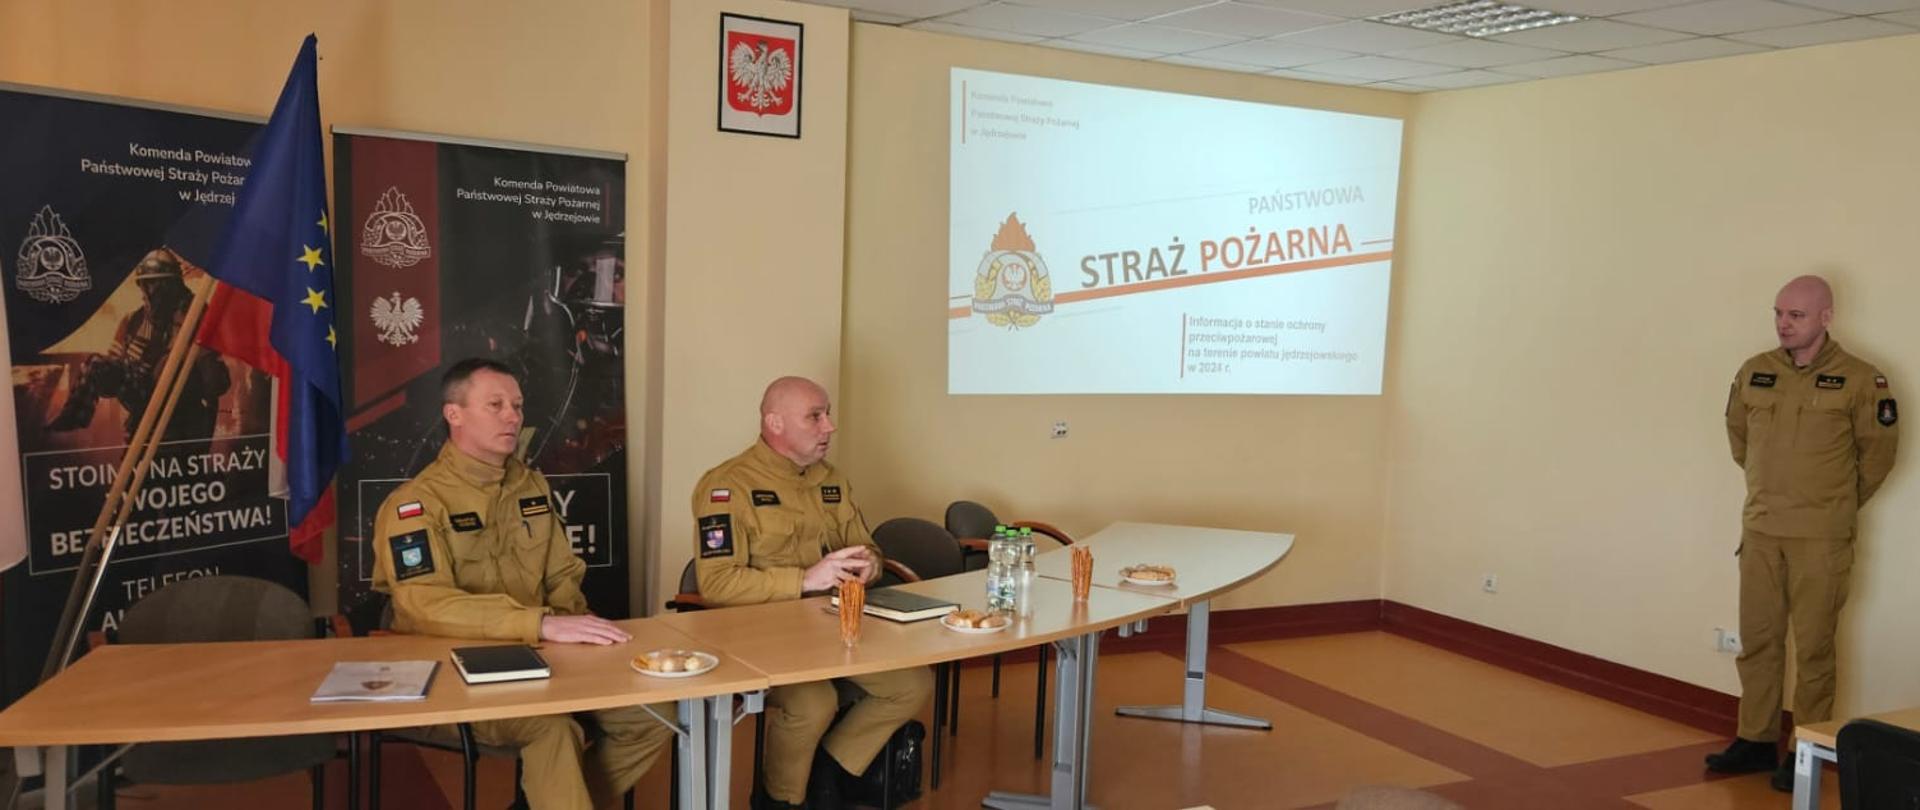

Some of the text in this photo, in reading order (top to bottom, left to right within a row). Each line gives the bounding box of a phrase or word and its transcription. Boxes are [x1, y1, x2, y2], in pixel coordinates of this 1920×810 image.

[129, 142, 252, 167] Komenda Powiatow
[81, 159, 245, 185] Państwowej Straży Pożar
[494, 176, 600, 195] Komenda Powiatowa
[179, 189, 235, 208] w Jędrzej
[457, 188, 600, 211] Państwowej Straży Pożarnej
[1248, 185, 1365, 215] PAŃSTWOWA
[531, 209, 600, 224] w Jędrzejowie
[1080, 223, 1353, 288] STRAŻ POŻARNA
[1189, 316, 1326, 333] Informacja o stanie ochrony
[1187, 349, 1201, 358] na
[1203, 347, 1238, 359] terenie
[1239, 349, 1280, 361] powiatu
[1187, 364, 1197, 373] w
[150, 457, 183, 479] NA
[187, 446, 265, 475] STRAŻY
